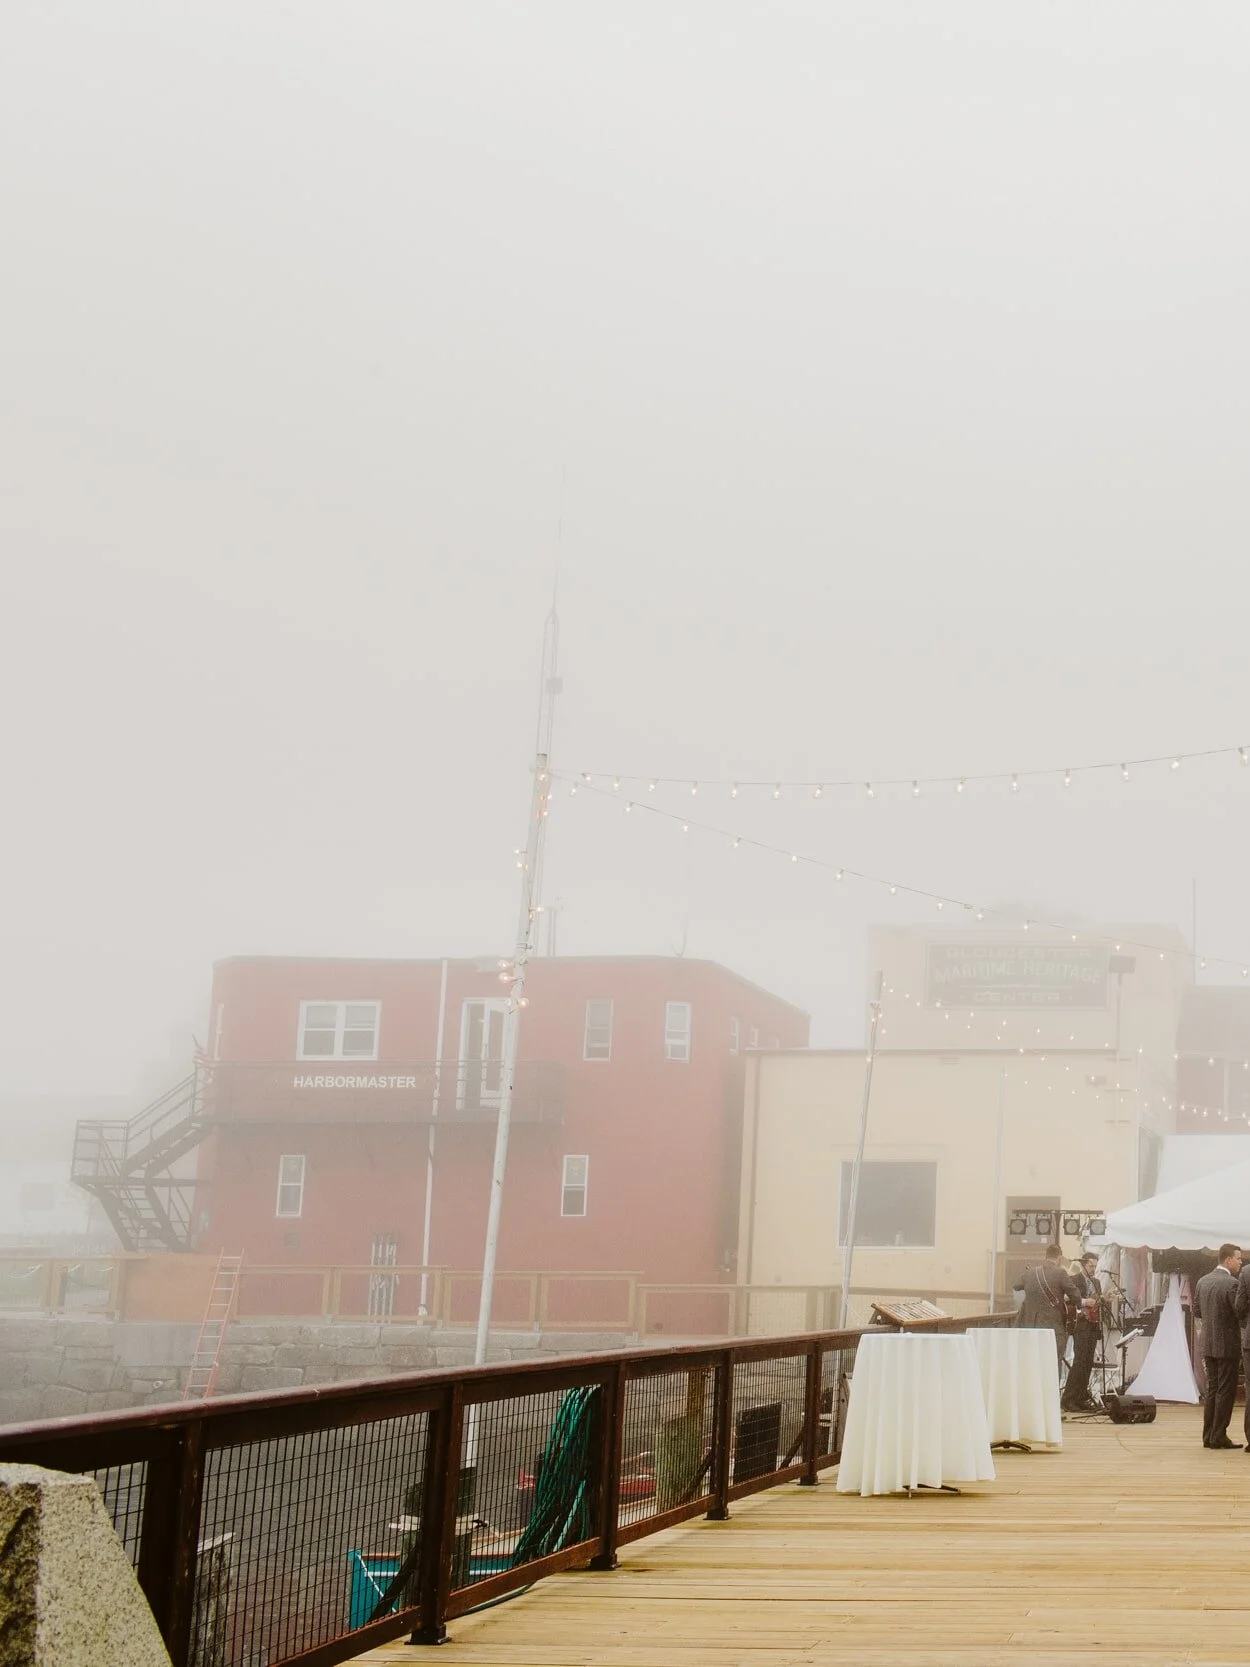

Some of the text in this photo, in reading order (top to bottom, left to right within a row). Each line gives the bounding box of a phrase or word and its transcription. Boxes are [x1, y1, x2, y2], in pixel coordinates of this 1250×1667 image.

[946, 947, 1092, 959] GLOUCESTER
[935, 960, 1102, 984] MARITIME HERITAGE
[974, 992, 1060, 1002] CENTER
[293, 1075, 417, 1089] HARBORMASTER
